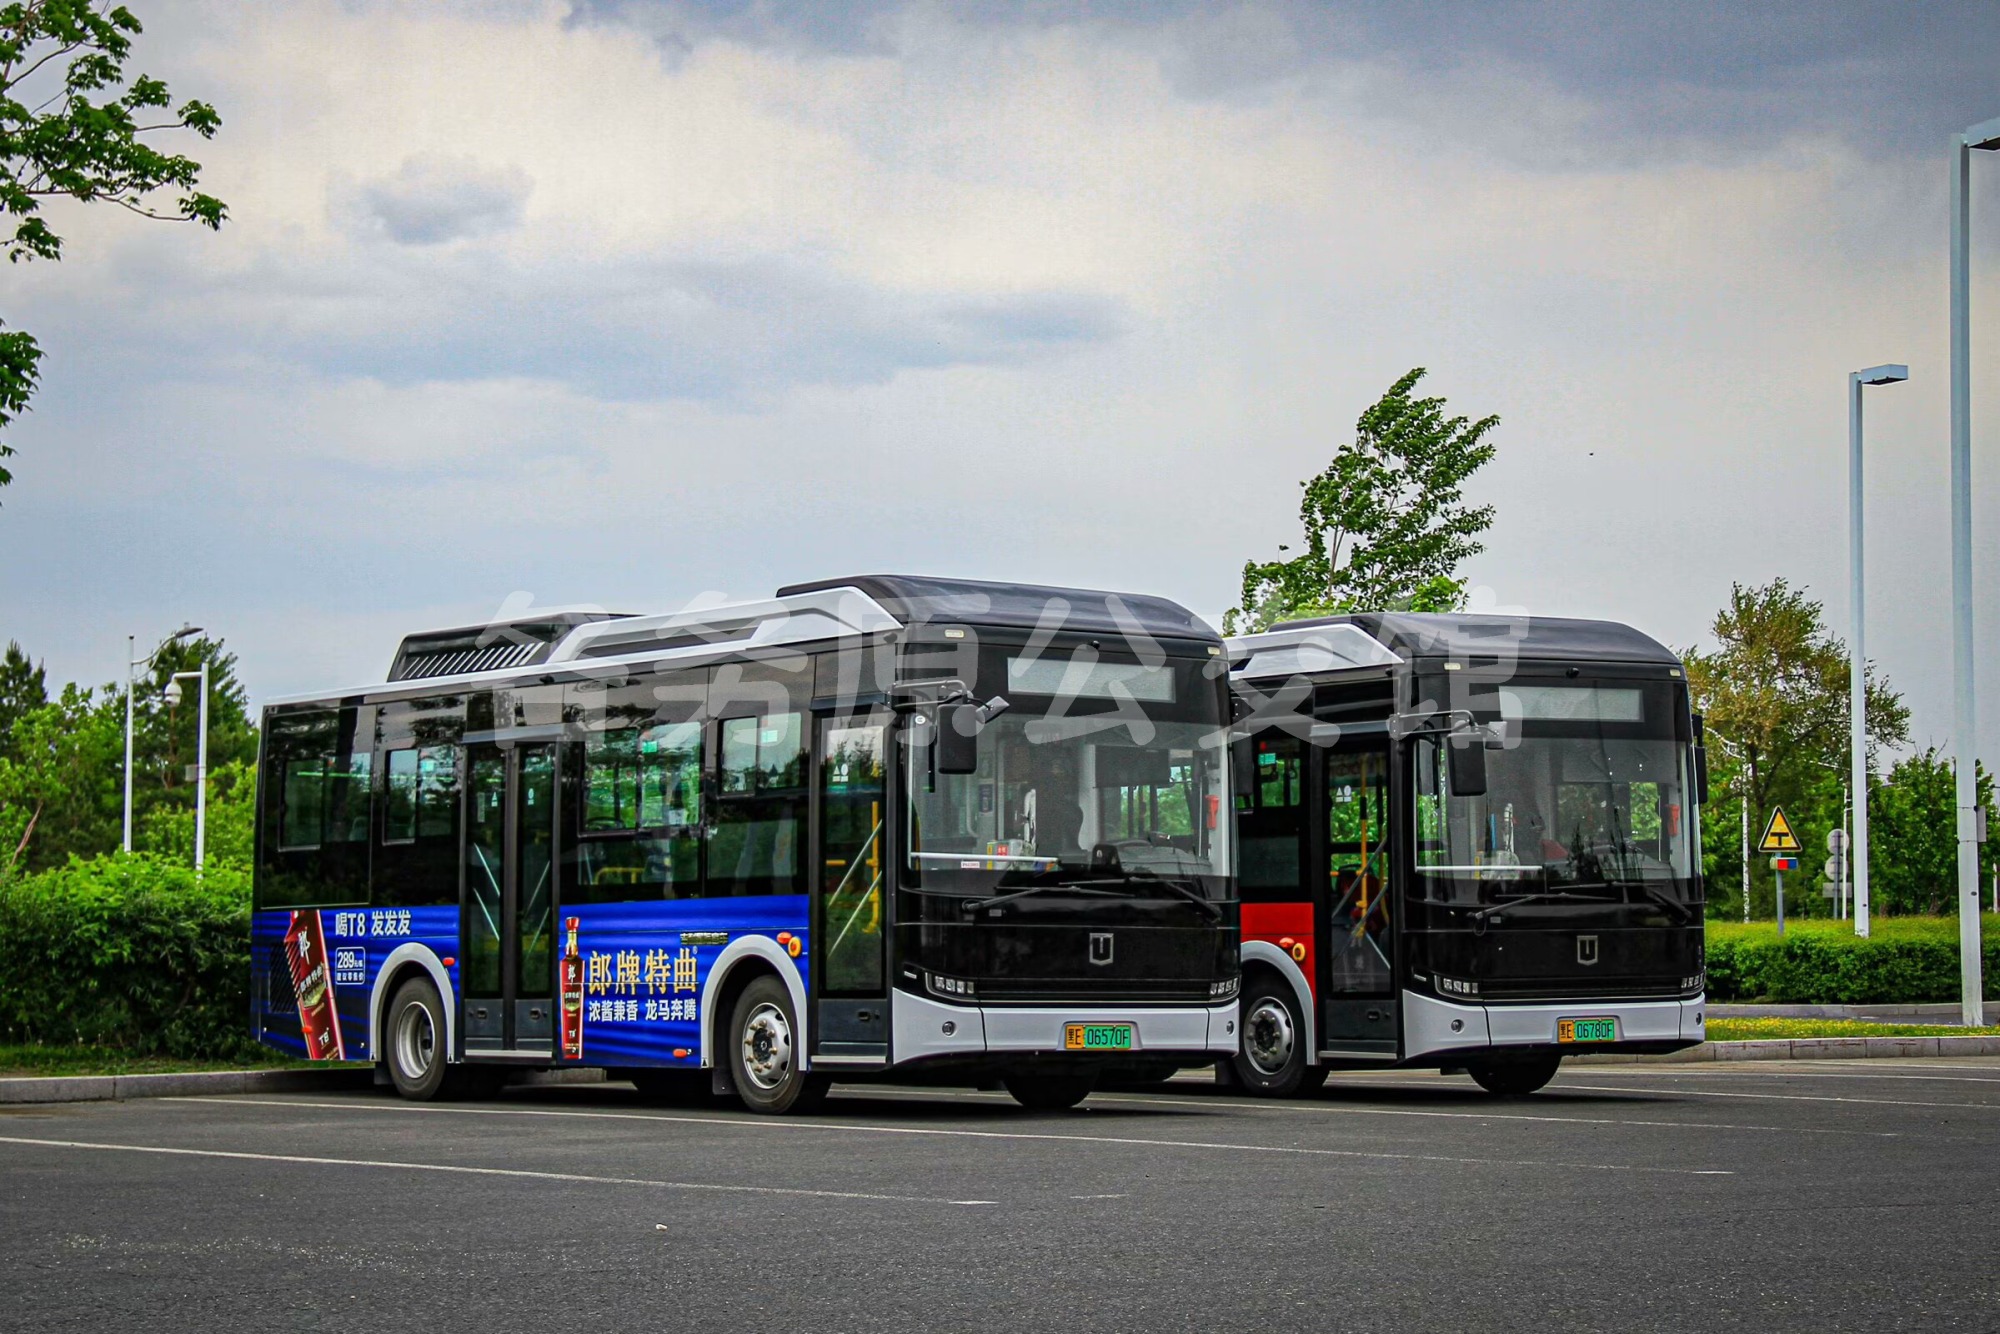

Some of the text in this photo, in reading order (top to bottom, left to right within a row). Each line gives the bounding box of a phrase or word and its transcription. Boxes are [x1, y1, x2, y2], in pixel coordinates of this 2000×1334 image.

[335, 909, 412, 937] 喝T8 发发发
[588, 947, 697, 996] 郎牌特曲
[588, 998, 696, 1022] 浓酱兼香 龙马奔腾
